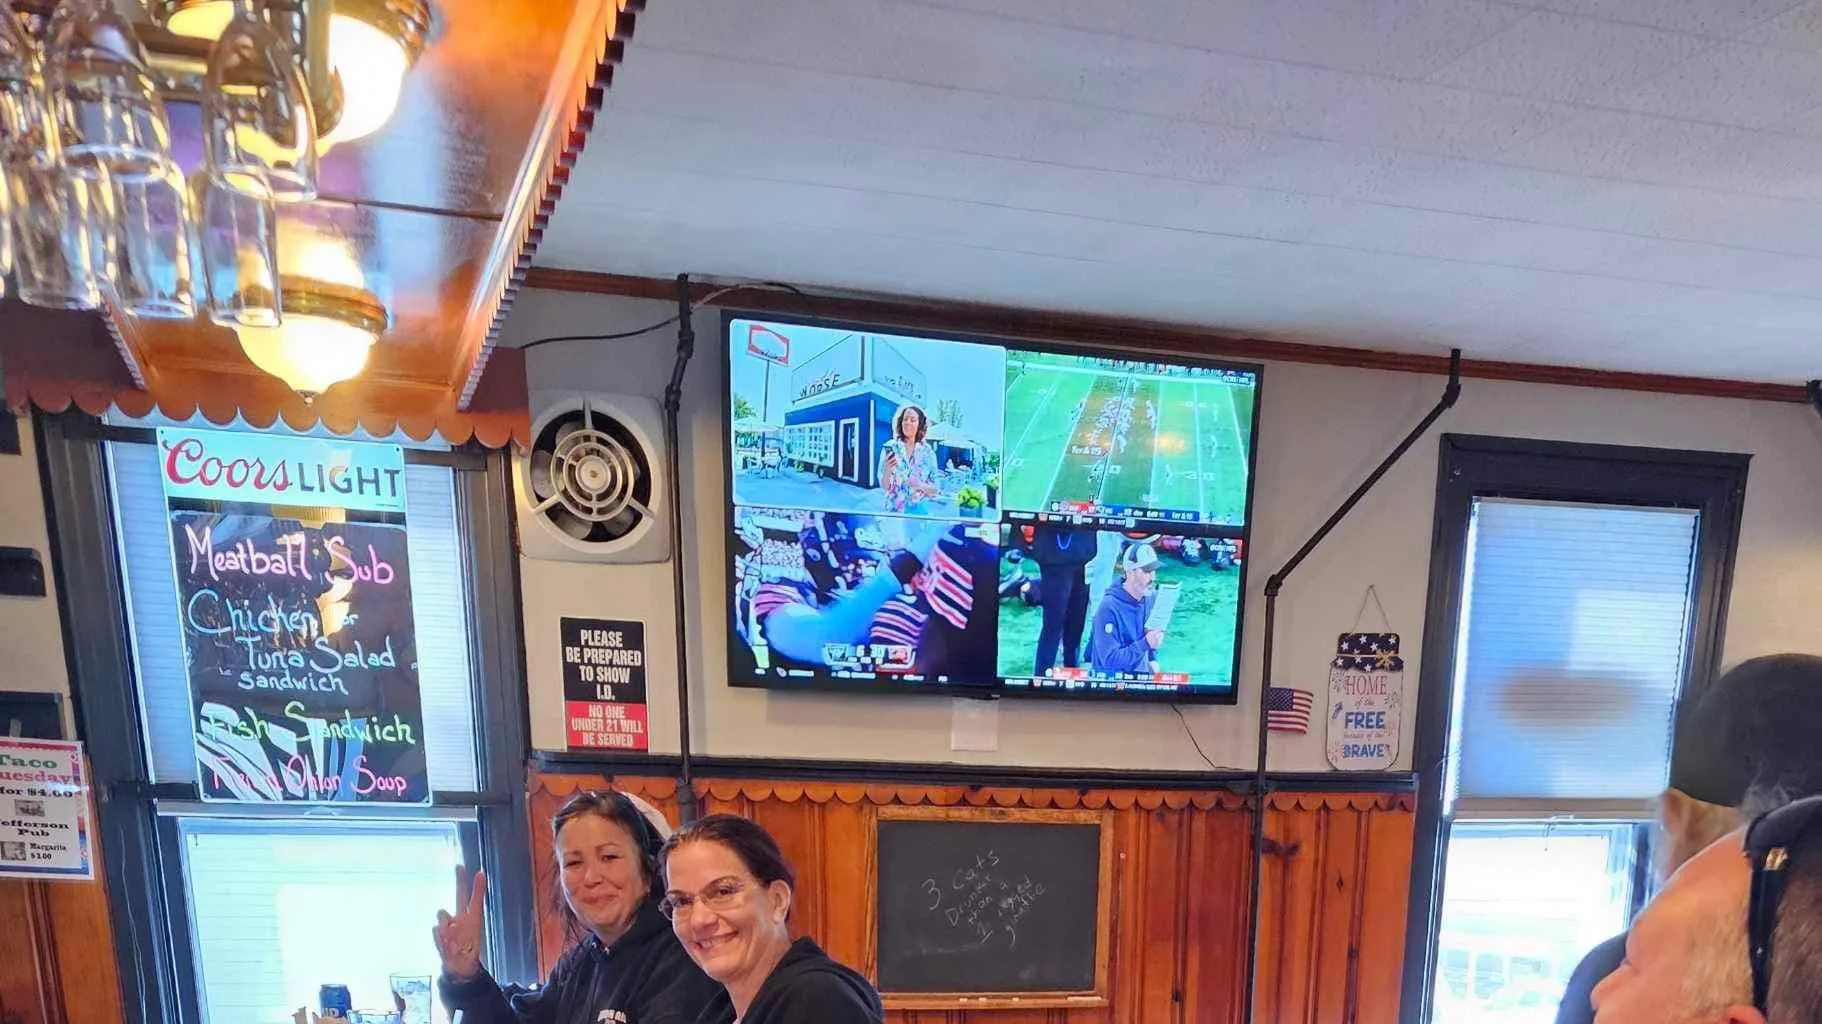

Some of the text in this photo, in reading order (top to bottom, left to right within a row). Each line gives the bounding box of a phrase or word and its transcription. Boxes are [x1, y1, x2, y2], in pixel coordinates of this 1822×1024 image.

[161, 437, 401, 498] Coors LIGHT
[184, 523, 394, 585] Meatball Sub
[187, 588, 317, 640] Chicken
[580, 628, 624, 648] PLEASE
[234, 635, 396, 674] Tuna Salad
[565, 645, 643, 667] BE PREPARED
[579, 665, 631, 684] TO SHOW
[596, 683, 616, 701] I.D.
[1345, 675, 1387, 696] HOME
[589, 704, 626, 720] NO ONE
[1344, 711, 1386, 729] FREE
[571, 717, 644, 734] UNDER 21 WILL
[582, 732, 634, 748] BE SERVED
[1342, 744, 1385, 758] BRAVE
[0, 771, 72, 784] uesday
[349, 755, 408, 796] Soup
[0, 819, 70, 829] efferson
[17, 828, 50, 837] Pub
[29, 843, 67, 852] Margarita
[921, 878, 942, 910] 3
